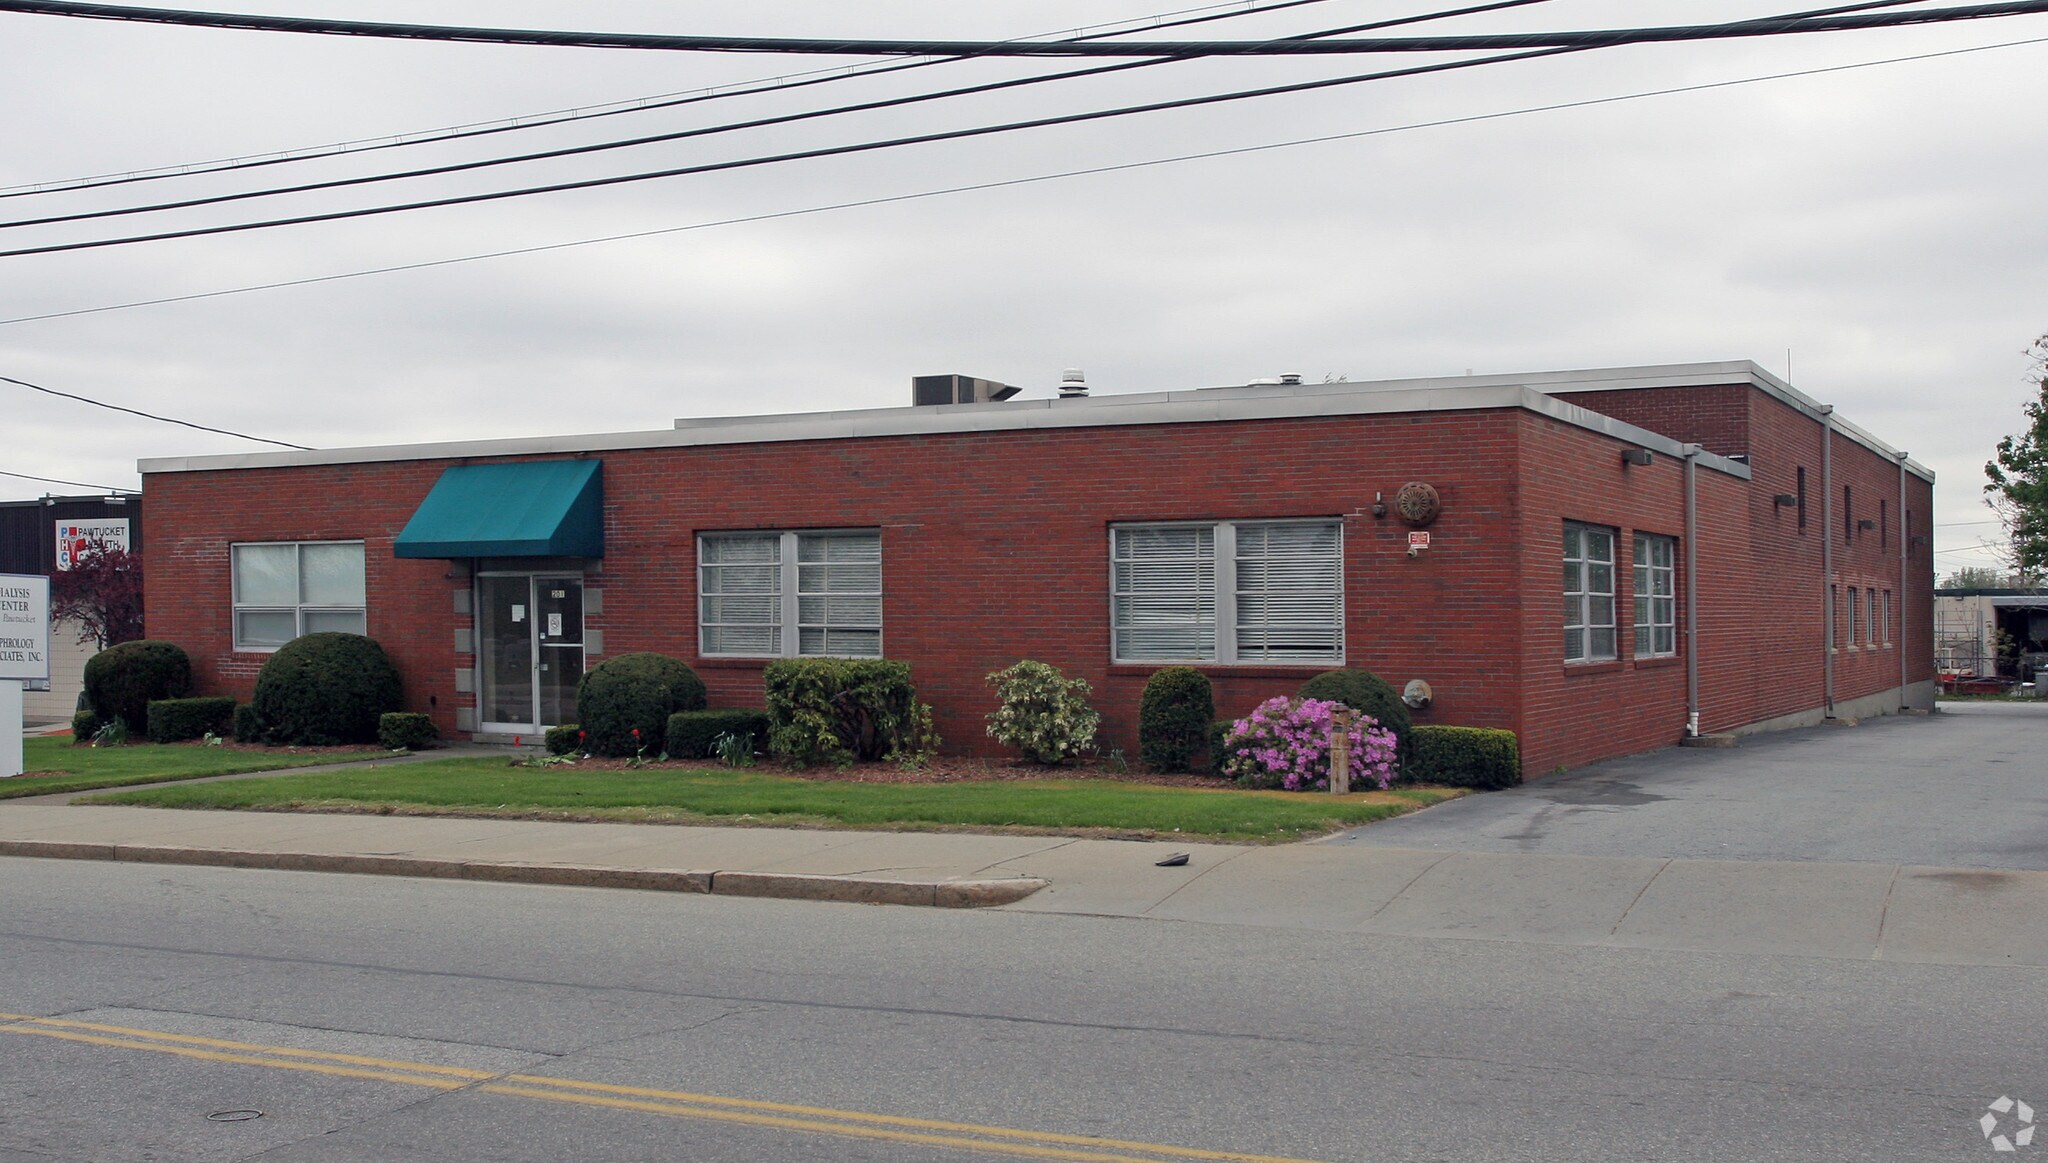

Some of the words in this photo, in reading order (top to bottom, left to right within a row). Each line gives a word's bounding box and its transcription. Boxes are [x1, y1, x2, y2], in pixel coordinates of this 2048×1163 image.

[61, 527, 67, 537] P
[78, 527, 125, 536] PAWTUCKET
[61, 552, 69, 563] C
[0, 600, 29, 612] ENTER
[28, 651, 43, 662] INC.
